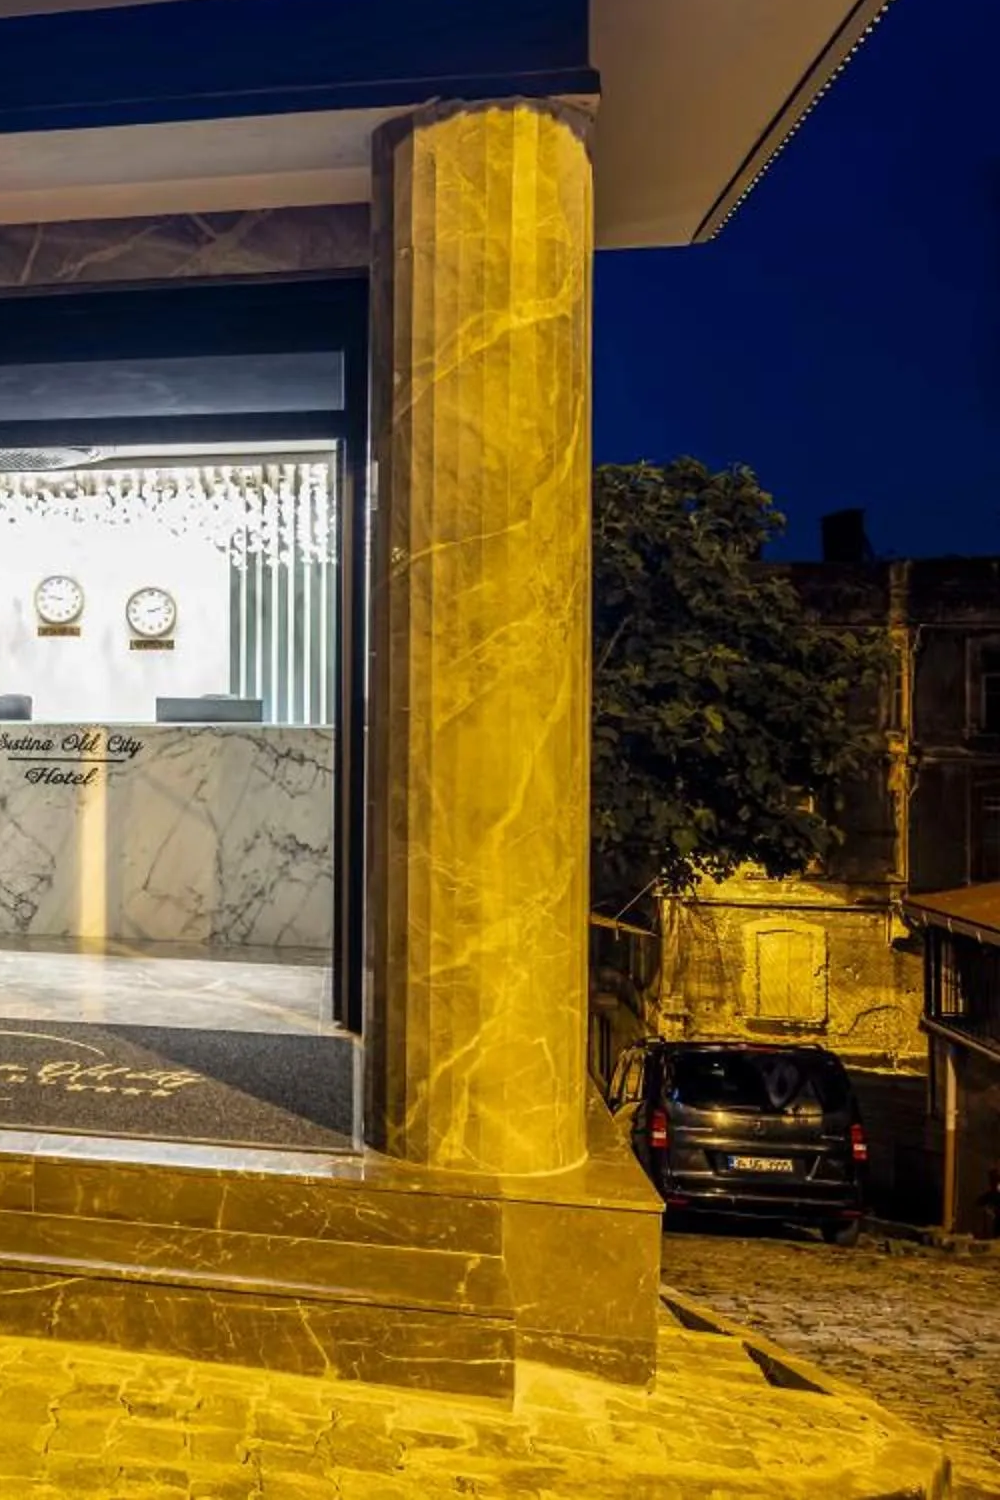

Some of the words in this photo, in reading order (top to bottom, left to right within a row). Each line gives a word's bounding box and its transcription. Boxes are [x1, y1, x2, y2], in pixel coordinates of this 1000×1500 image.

[61, 732, 101, 753] Old
[107, 733, 144, 759] City
[25, 767, 98, 786] Hotel
